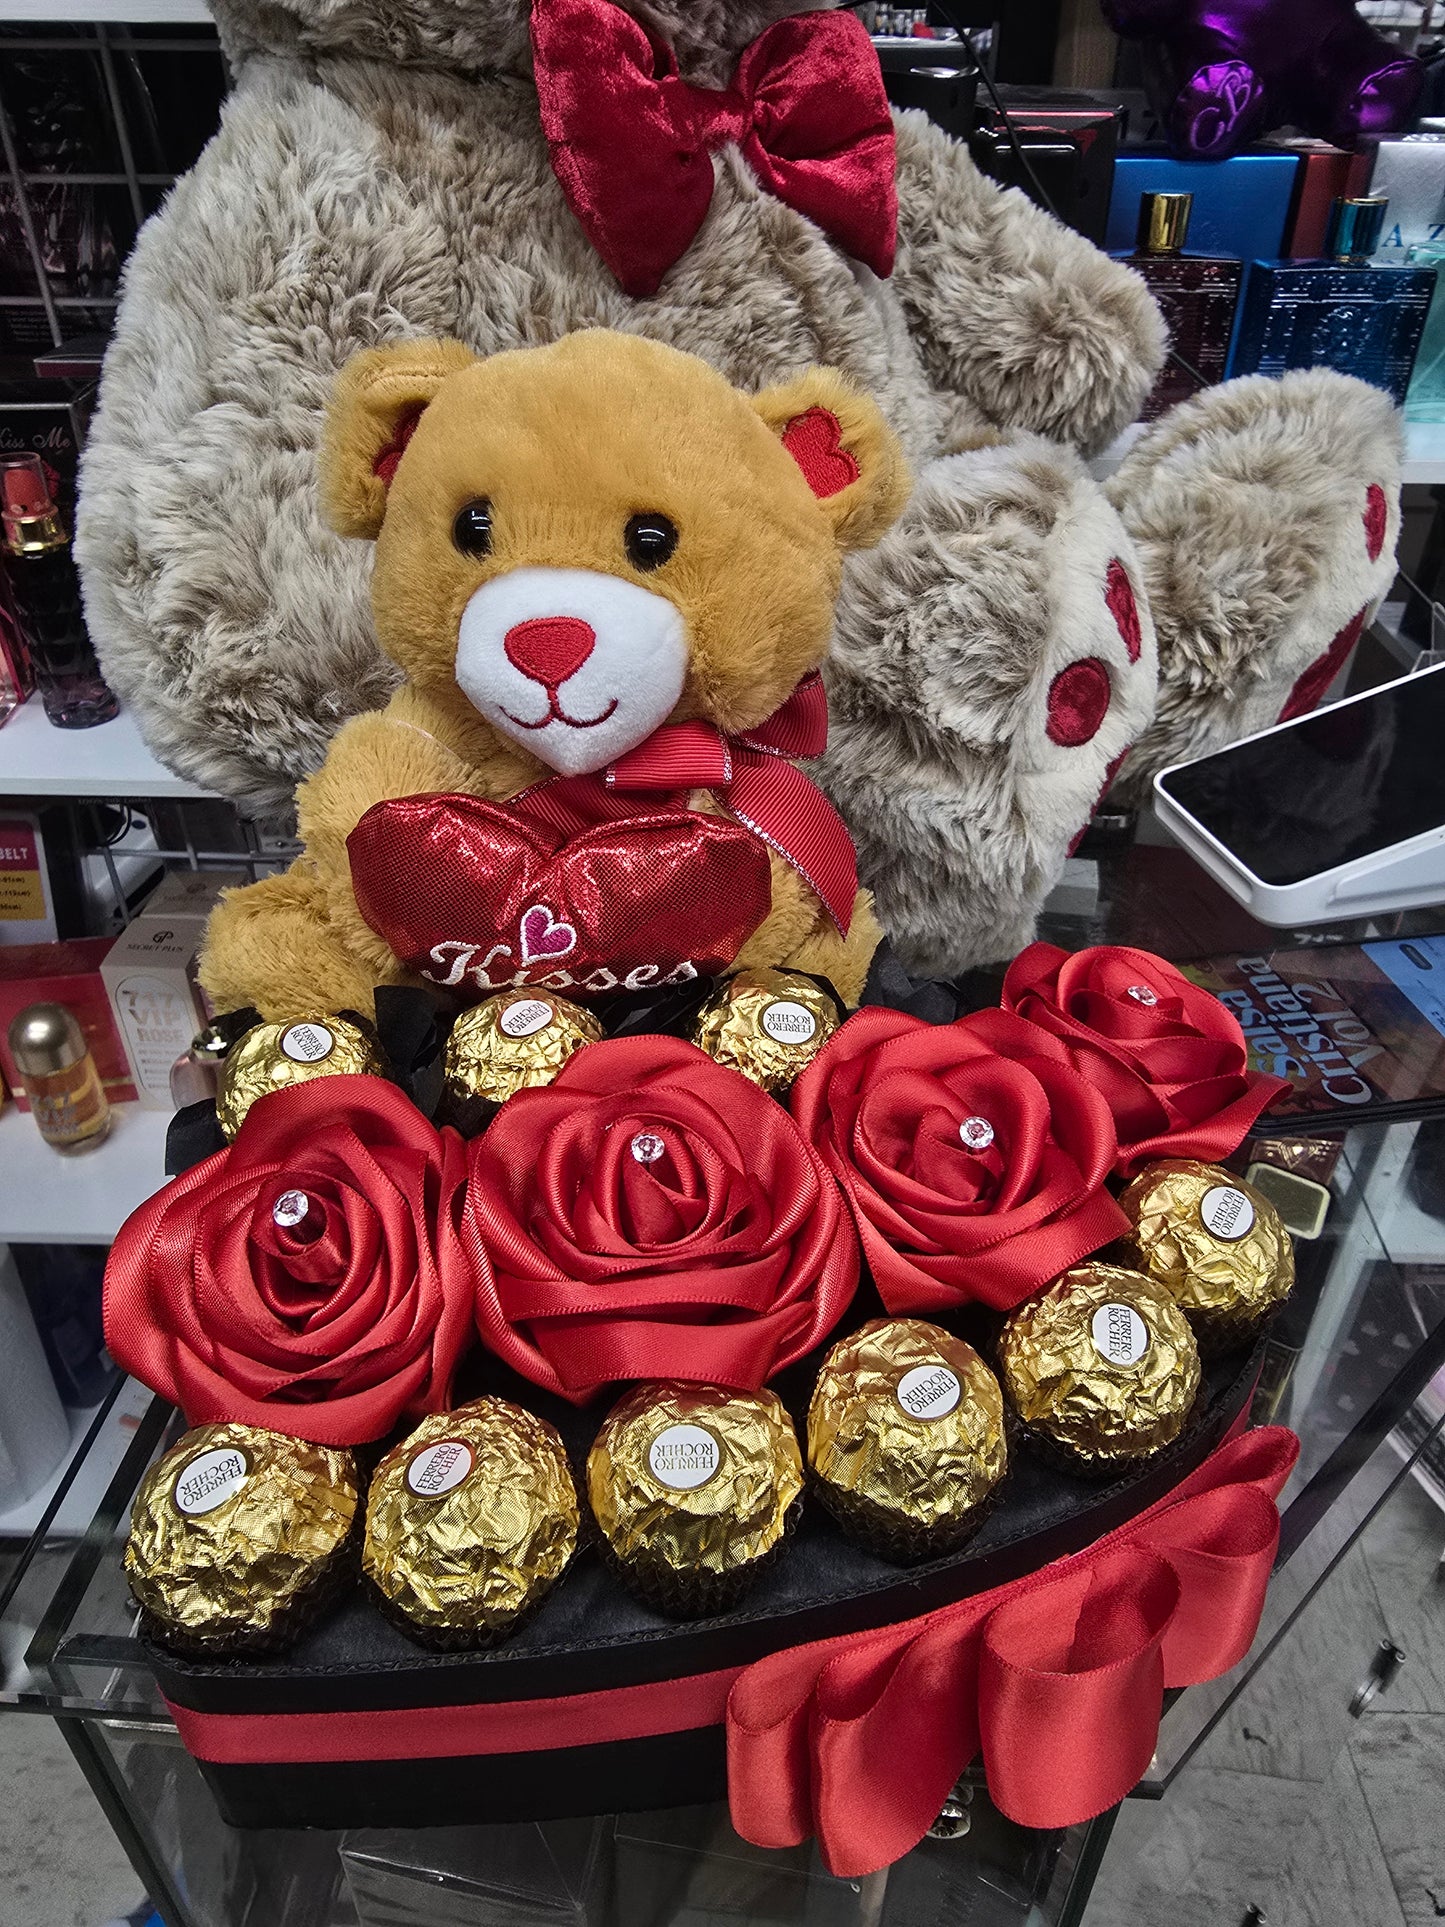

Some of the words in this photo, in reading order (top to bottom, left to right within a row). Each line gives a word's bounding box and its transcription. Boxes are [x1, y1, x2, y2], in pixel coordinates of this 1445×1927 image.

[32, 426, 71, 449] Me
[420, 930, 698, 990] Kisses
[1291, 978, 1344, 1004] 2
[767, 1013, 811, 1024] ROCHER
[767, 1022, 811, 1034] FERRERO
[1217, 989, 1307, 1078] Salsa
[1236, 957, 1373, 1105] Cristiana
[291, 1029, 317, 1059] ROCHER
[299, 1025, 326, 1055] FERRERO
[1209, 1189, 1236, 1229] ROCHER
[1220, 1194, 1246, 1236] FERRERO
[1107, 1307, 1120, 1358] ROCHER
[1119, 1308, 1132, 1361] FERRERO
[901, 1369, 948, 1405] ROCHER
[910, 1377, 957, 1414] FERRERO
[415, 1445, 450, 1490] FERRERO
[427, 1446, 464, 1491] ROCHER
[654, 1457, 714, 1471] FERRERO
[655, 1443, 713, 1457] ROCHER
[180, 1455, 239, 1495] ROCHER
[183, 1464, 242, 1507] FERRERO
